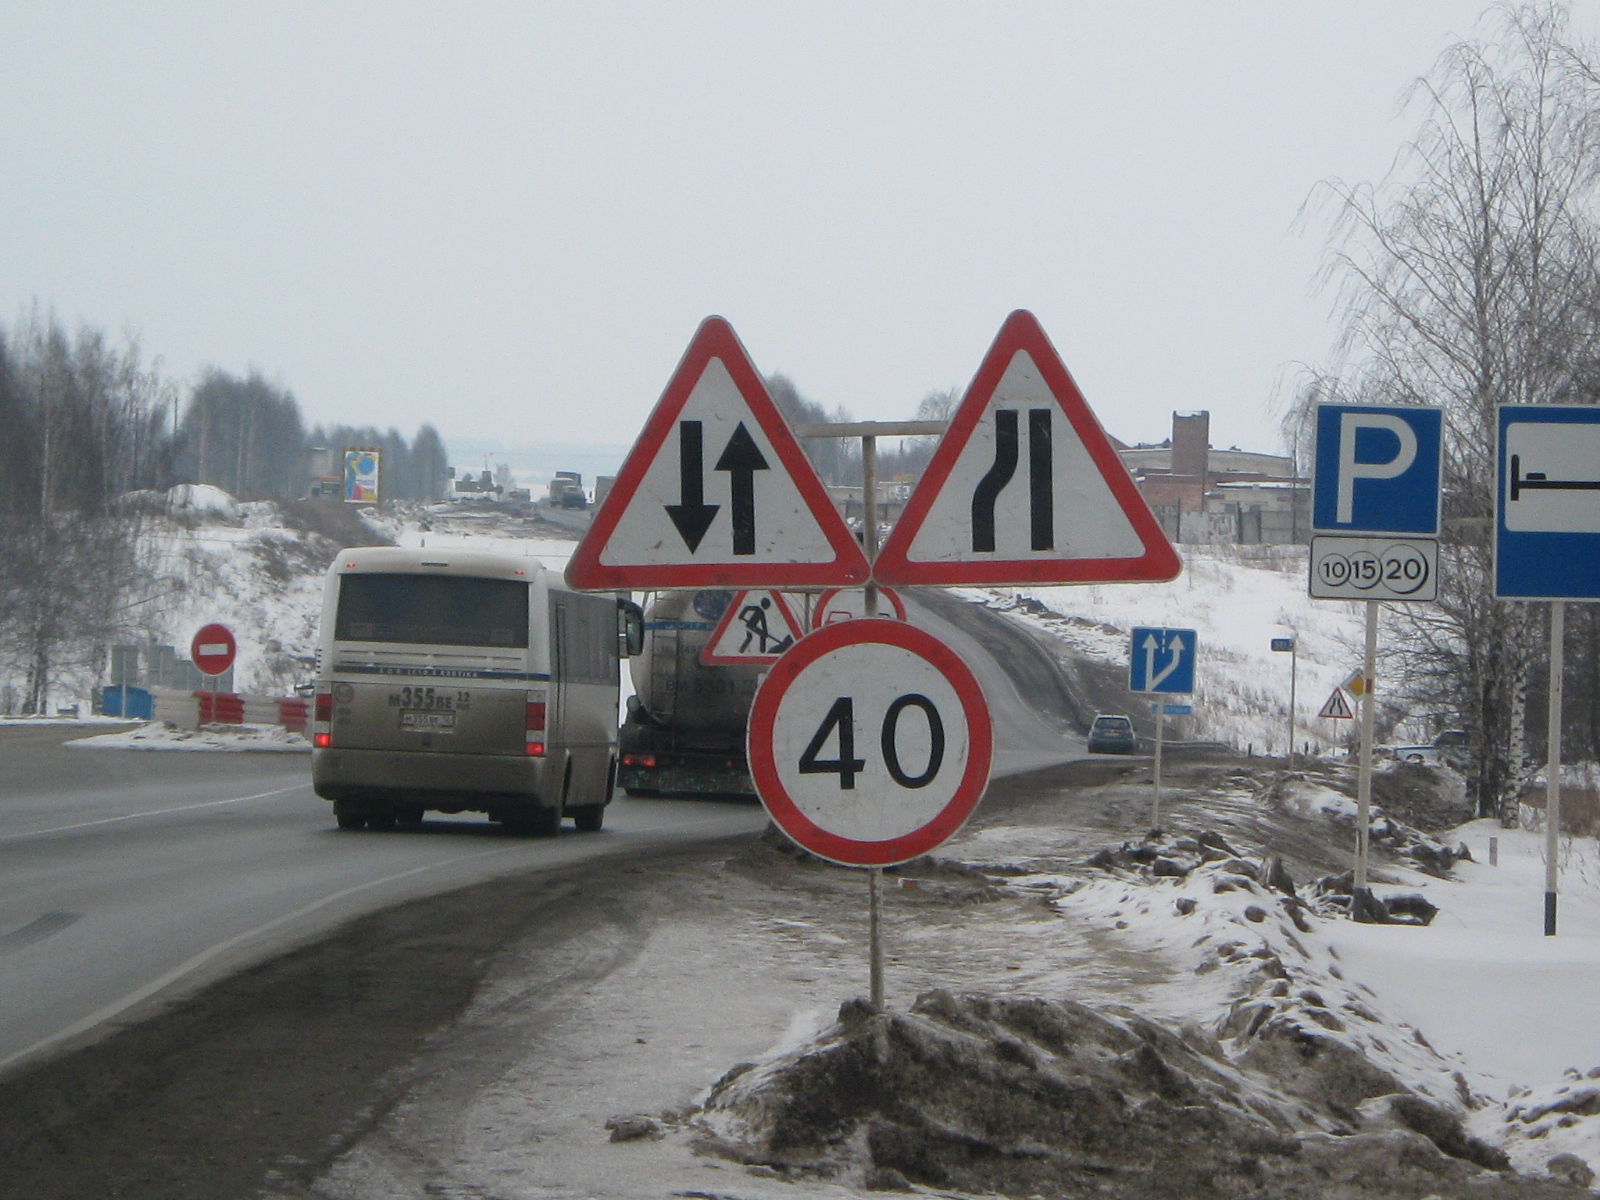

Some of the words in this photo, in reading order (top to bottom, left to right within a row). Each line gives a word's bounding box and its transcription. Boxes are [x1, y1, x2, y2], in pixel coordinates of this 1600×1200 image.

[1336, 413, 1418, 523] P
[1324, 561, 1346, 579] 10
[1352, 560, 1376, 580] 15
[1386, 558, 1421, 580] 20
[799, 693, 945, 790] 40
